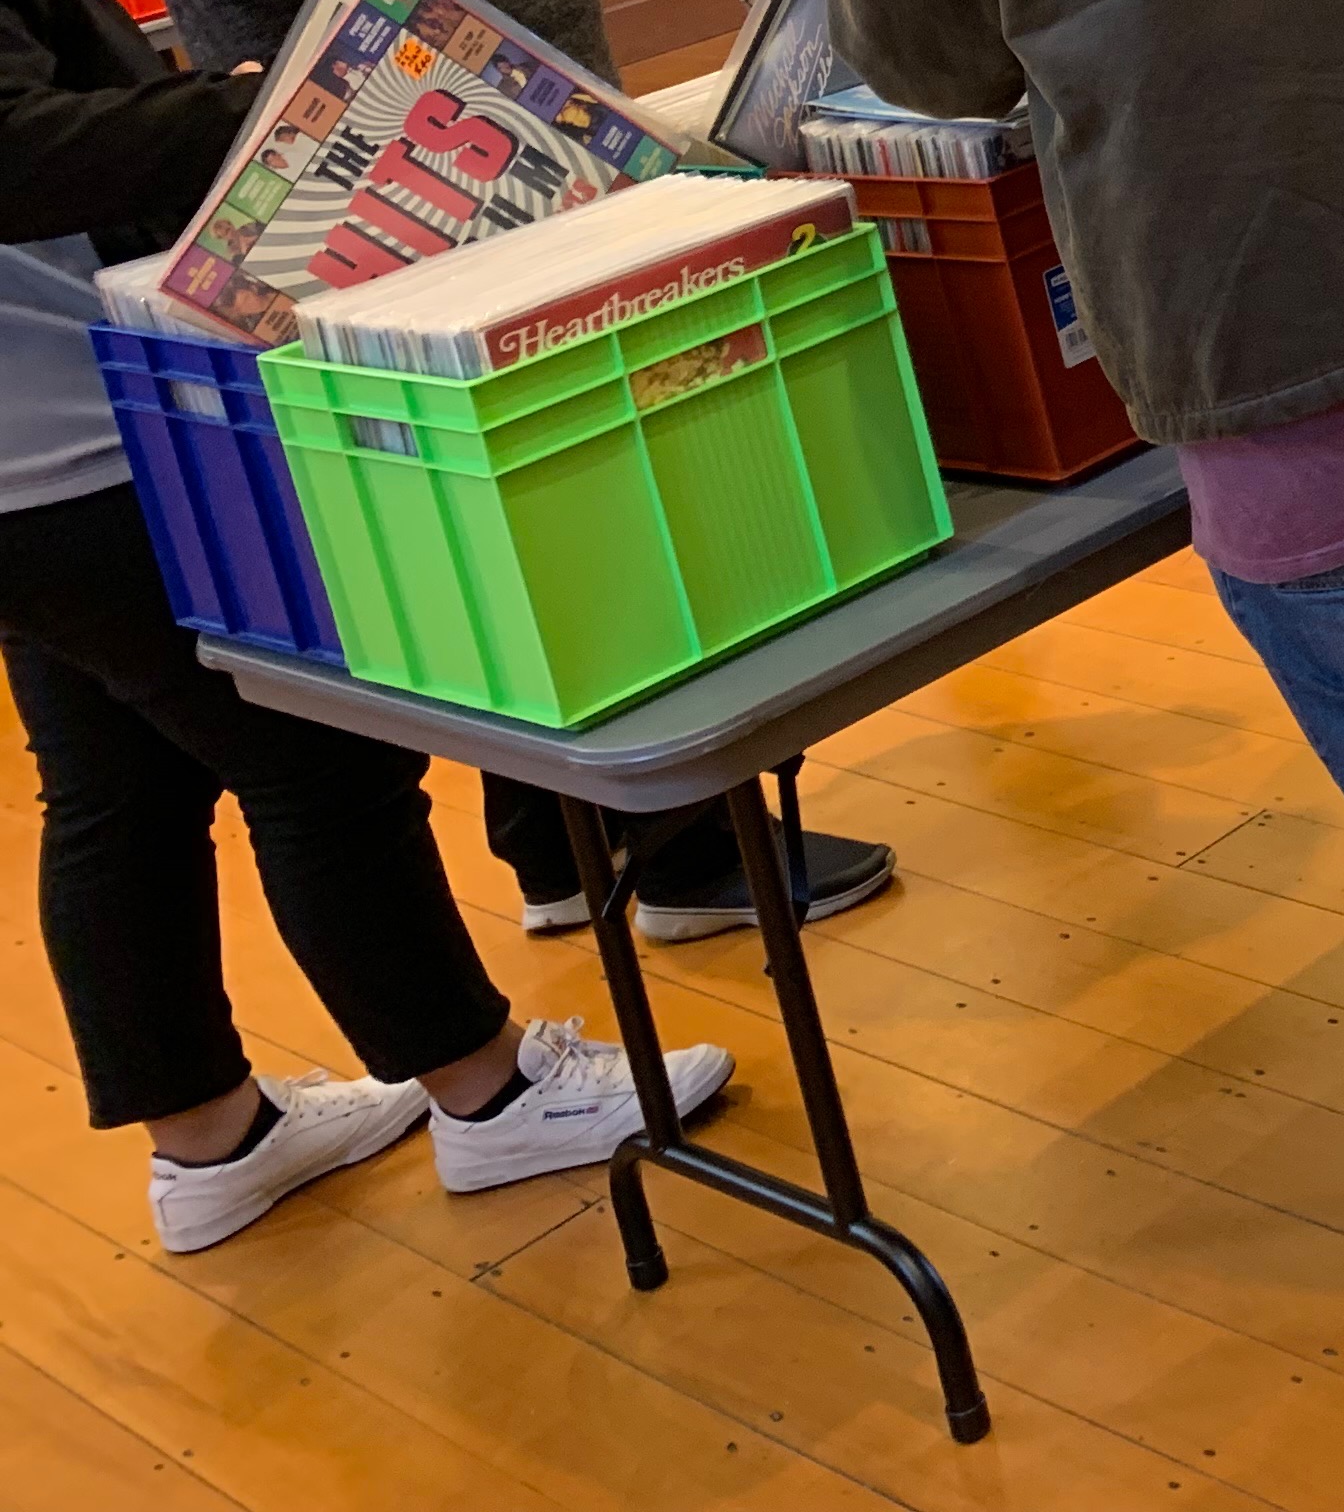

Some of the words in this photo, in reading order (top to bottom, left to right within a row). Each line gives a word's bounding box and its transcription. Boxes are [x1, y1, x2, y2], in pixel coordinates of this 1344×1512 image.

[314, 125, 380, 191] THE
[499, 255, 746, 362] Heartbreakers
[544, 1108, 585, 1120] Reebok
